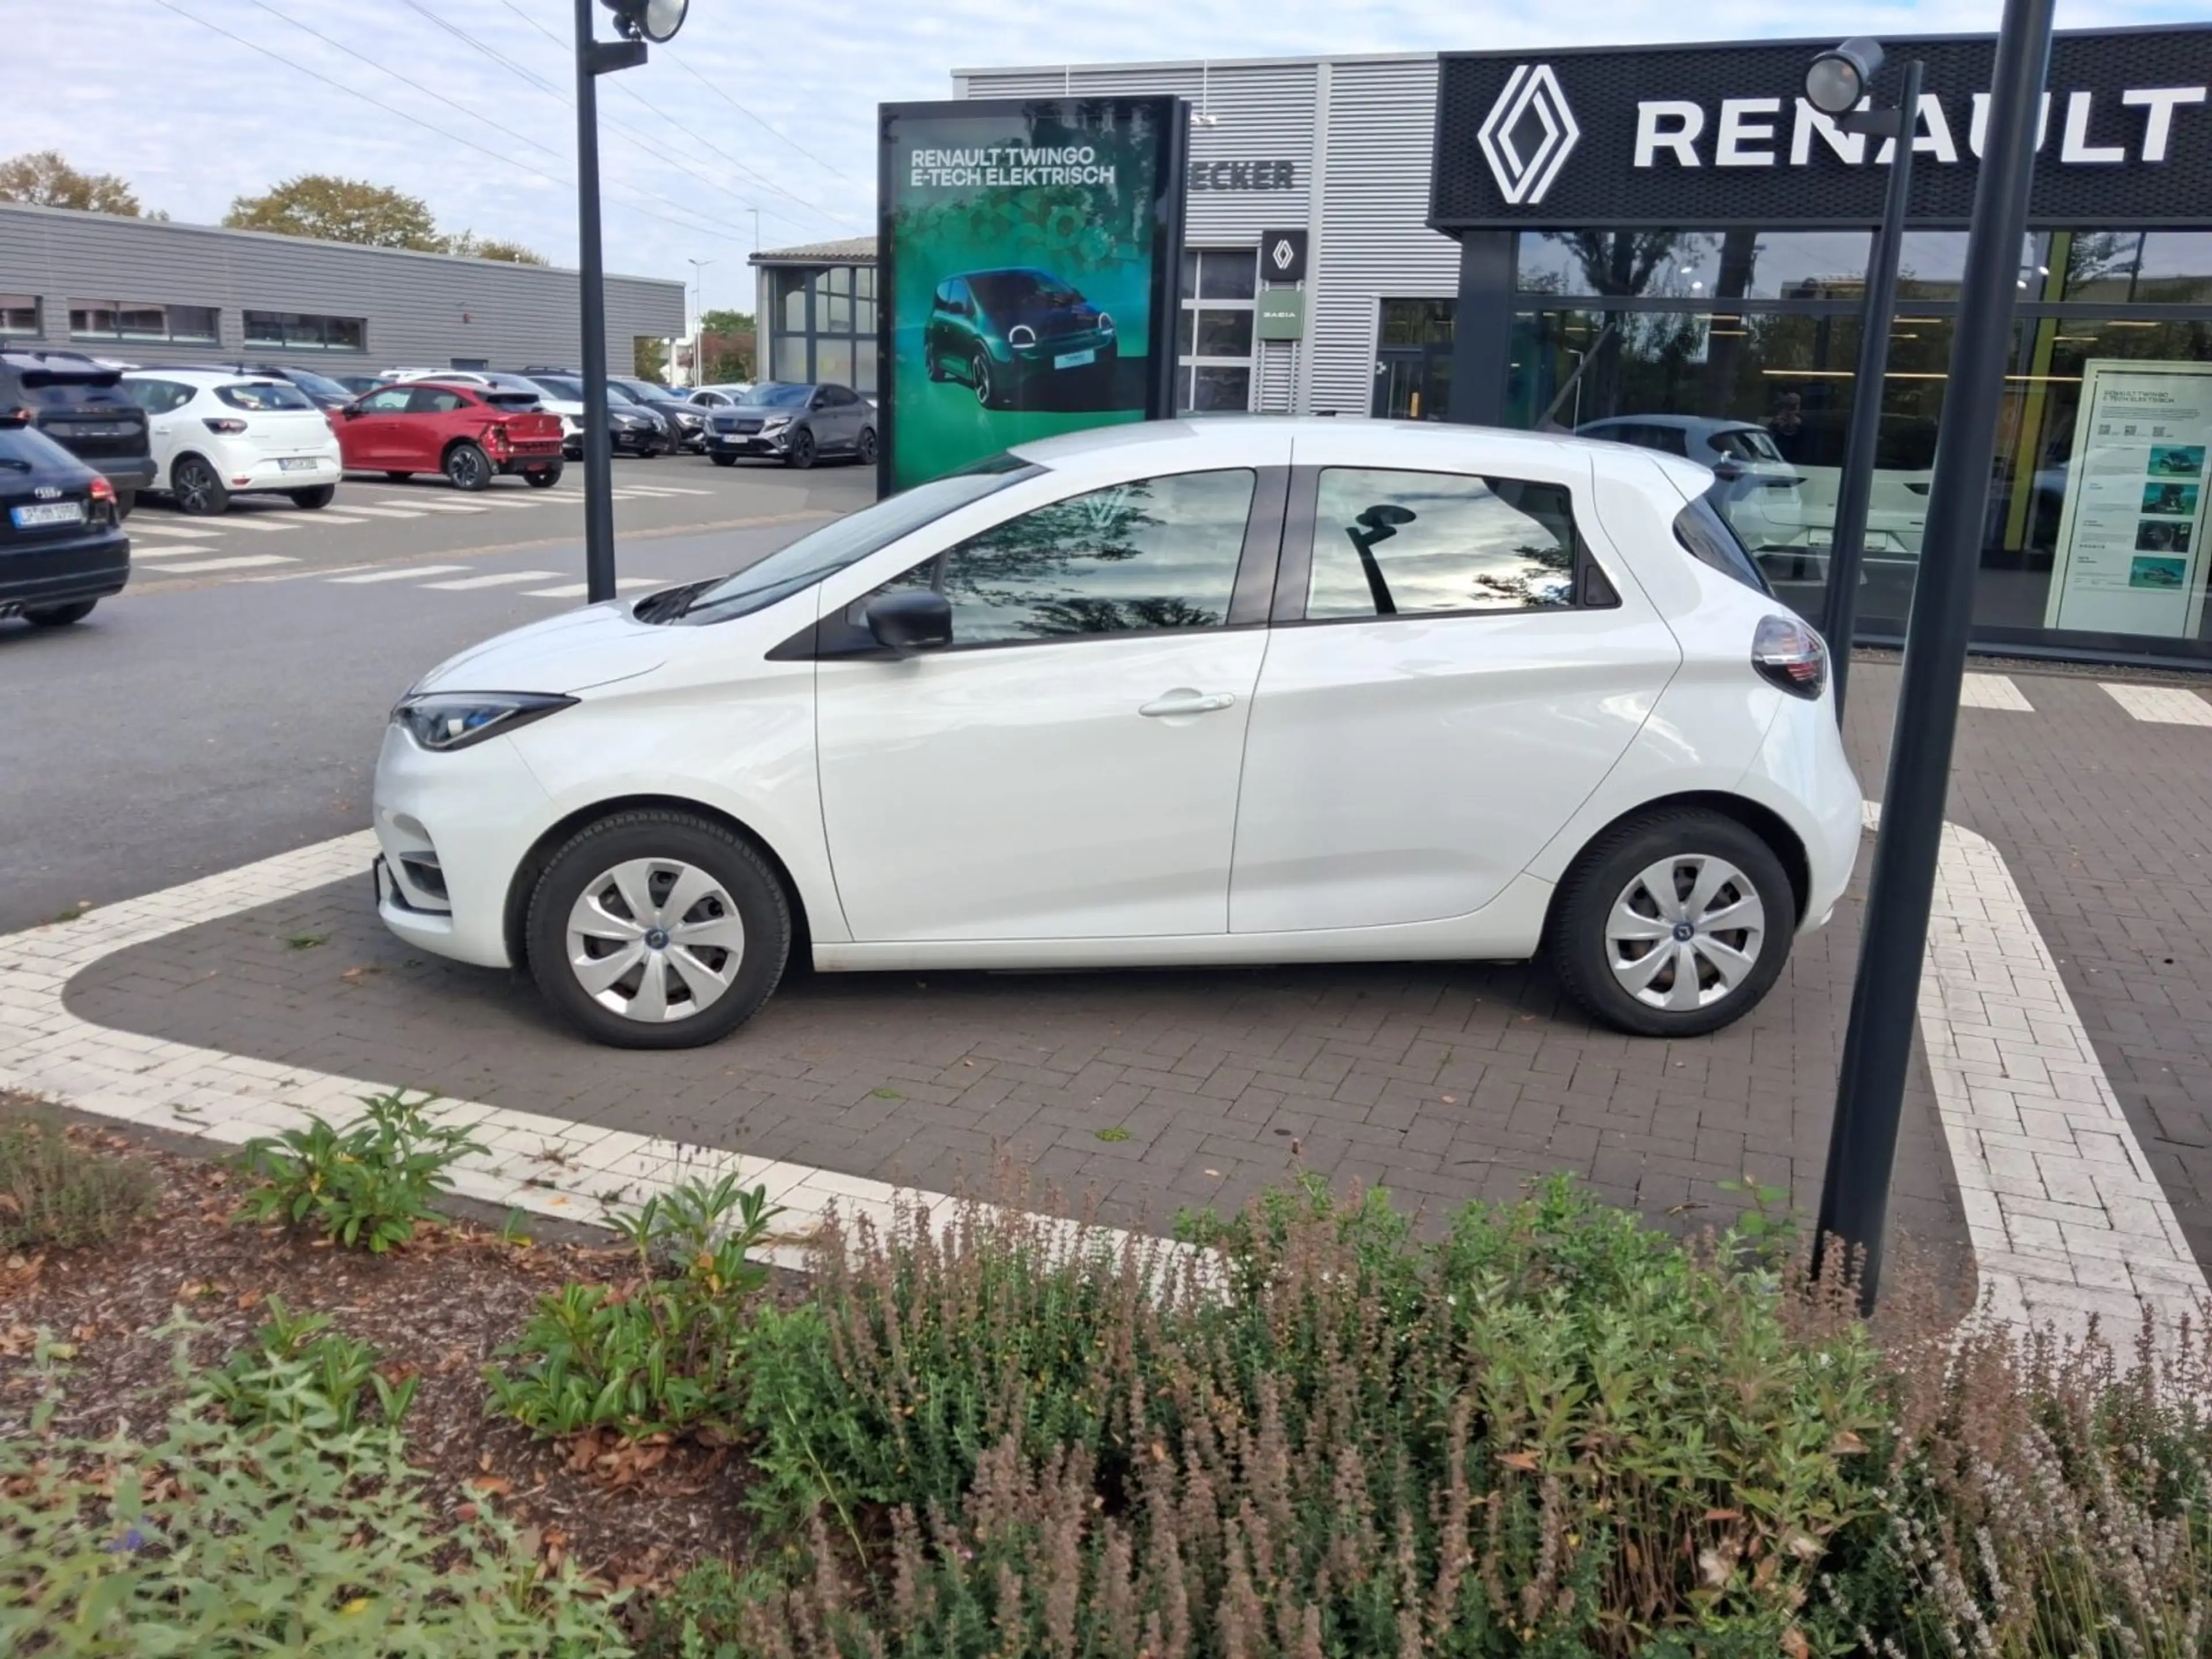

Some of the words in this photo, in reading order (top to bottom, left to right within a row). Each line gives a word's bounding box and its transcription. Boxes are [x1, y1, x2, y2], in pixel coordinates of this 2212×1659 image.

[911, 149, 1001, 167] RENAULT
[1005, 146, 1095, 166] TWINGO
[910, 169, 980, 187] E-TECH
[985, 166, 1115, 186] ELEKTRISCH
